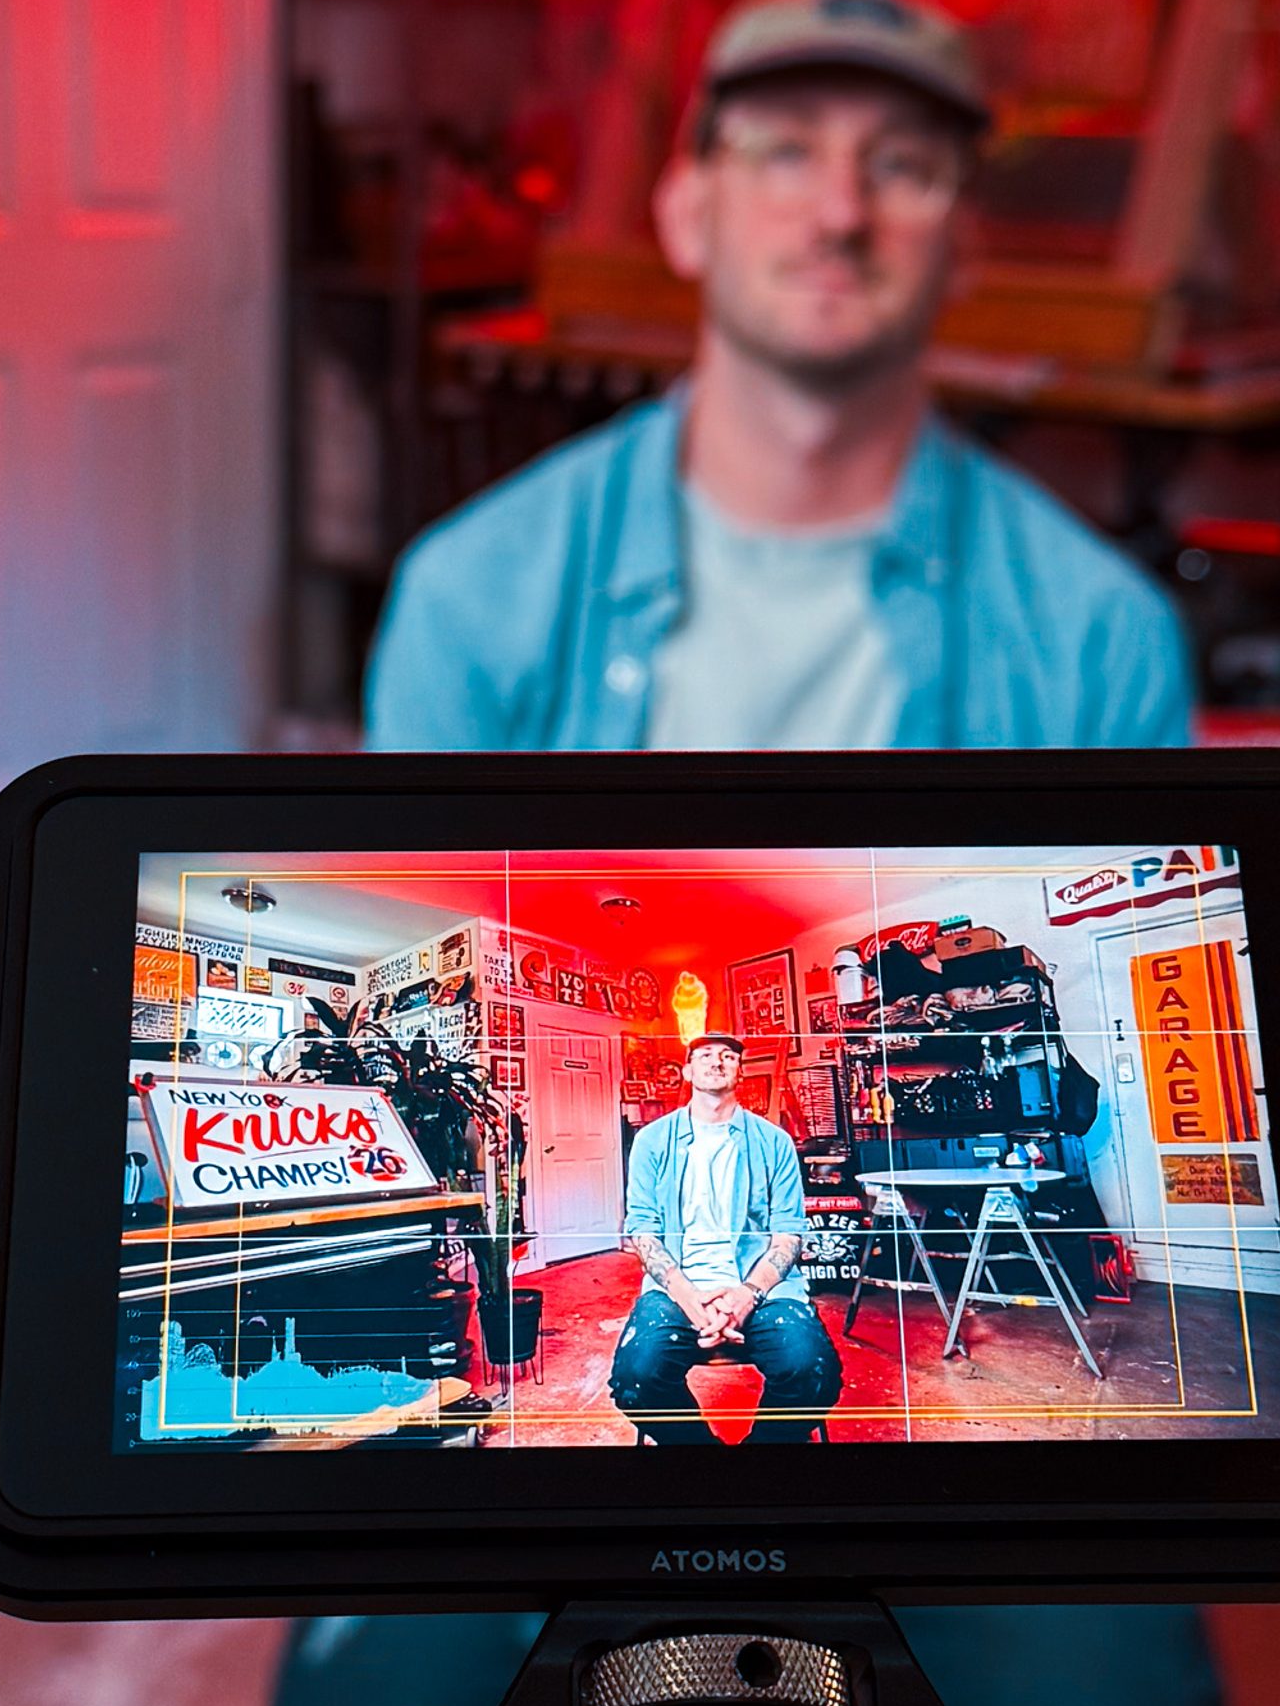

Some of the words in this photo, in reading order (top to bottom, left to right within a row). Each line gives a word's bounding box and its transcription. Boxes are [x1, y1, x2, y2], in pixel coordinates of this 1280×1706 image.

[1063, 869, 1119, 904] Quality
[1151, 955, 1206, 1138] GARAGE
[168, 1090, 226, 1106] NEW
[183, 1103, 381, 1163] Knicks
[192, 1155, 351, 1194] CHAMPS!
[828, 1213, 859, 1231] ZEE
[839, 1265, 861, 1279] CO
[651, 1549, 786, 1572] ATOMOS
